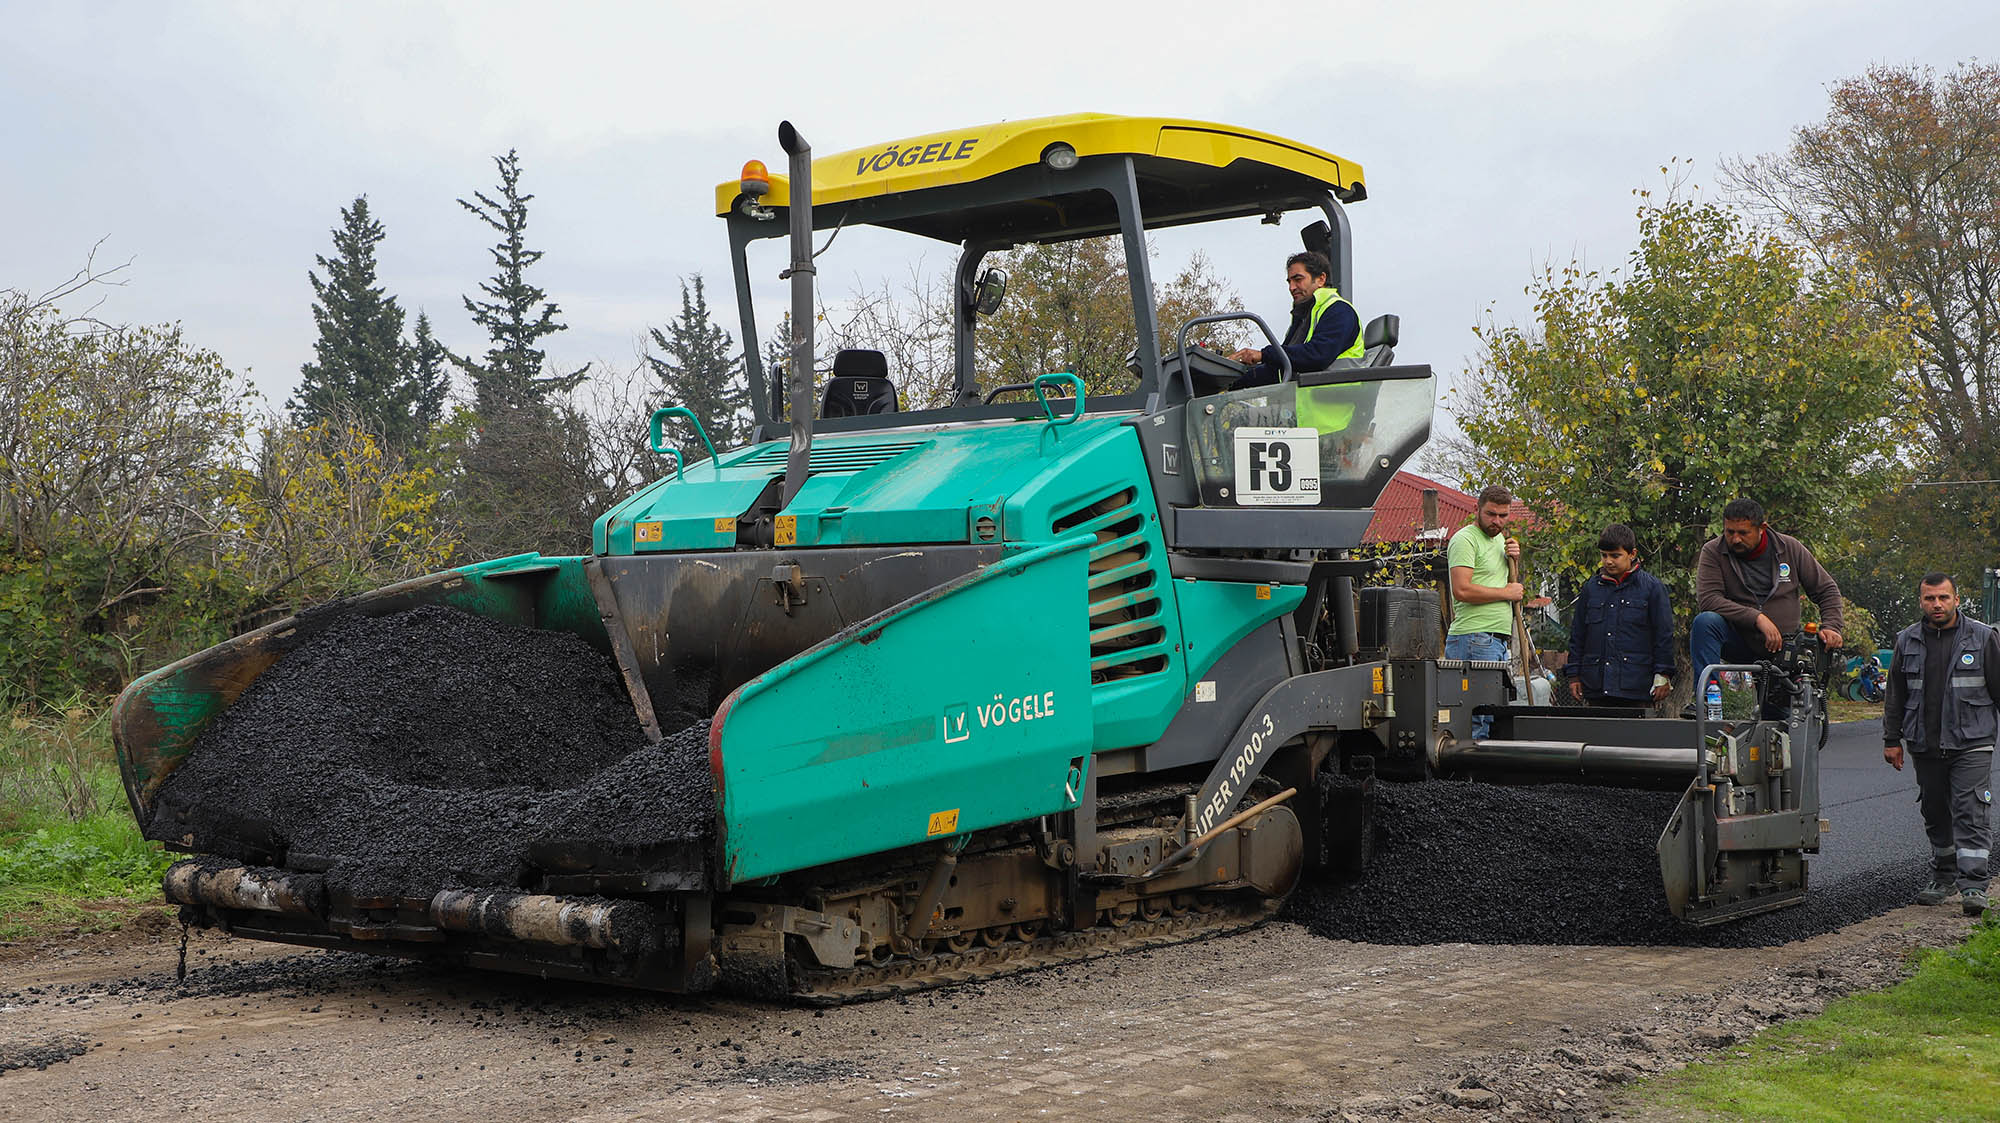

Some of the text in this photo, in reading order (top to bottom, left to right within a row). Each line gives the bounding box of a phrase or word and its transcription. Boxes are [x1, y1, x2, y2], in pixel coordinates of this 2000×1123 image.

[856, 138, 979, 176] VÖGELE
[1249, 441, 1292, 492] F3
[977, 691, 1055, 729] VÖGELE
[1195, 713, 1274, 838] UPER 1900-3
